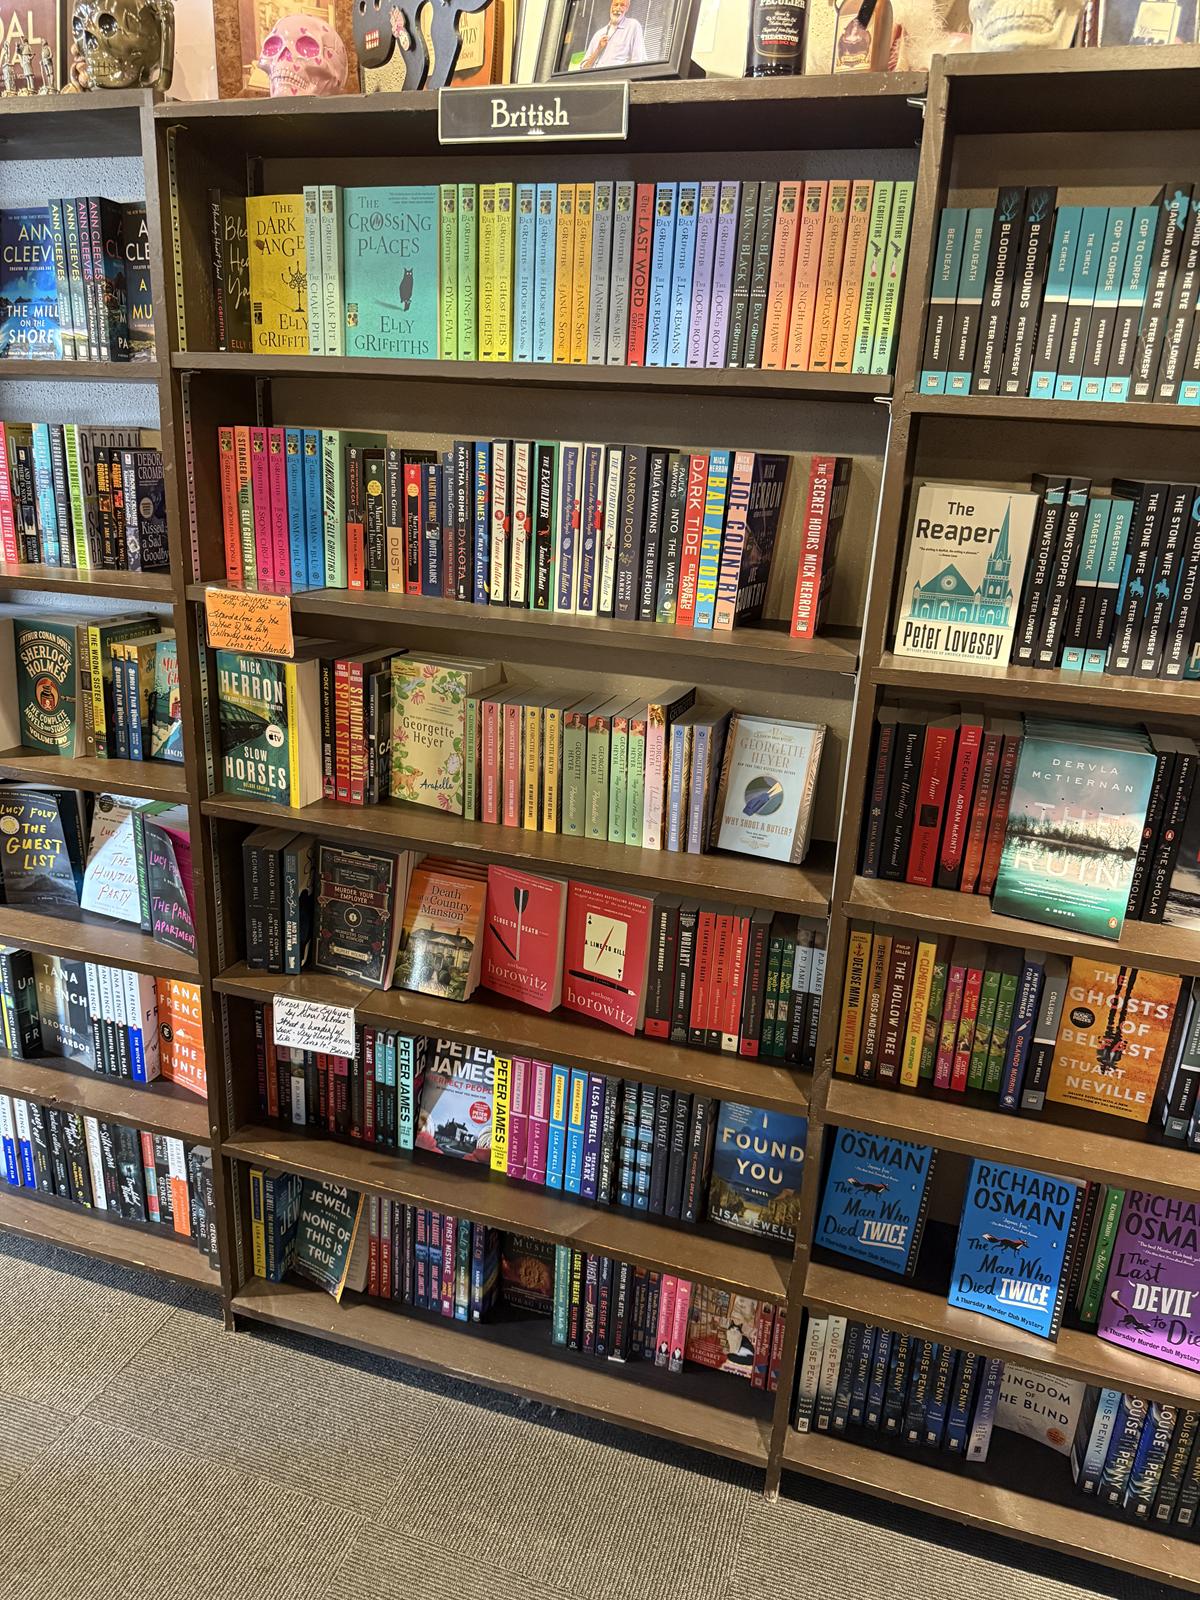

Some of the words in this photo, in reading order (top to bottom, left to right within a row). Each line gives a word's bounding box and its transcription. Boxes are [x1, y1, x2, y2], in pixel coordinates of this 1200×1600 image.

[491, 98, 569, 129] British
[79, 202, 87, 230] ANN
[272, 202, 293, 213] THE
[358, 196, 379, 208] THE
[51, 204, 61, 230] ANN
[67, 204, 75, 230] ANN
[257, 216, 295, 235] DARK
[358, 236, 419, 258] PLACES
[638, 217, 649, 253] LAST
[946, 228, 955, 247] BEAU
[4, 245, 54, 263] CLEEV
[53, 234, 65, 281] CLEEVES
[69, 234, 80, 281] CLEEVES
[80, 233, 92, 280] CLEEVES
[755, 245, 768, 282] BLACK
[991, 223, 1011, 307] BLOODHOUNDS
[1082, 249, 1092, 275] CIRCLE
[634, 260, 647, 307] WORD
[1130, 255, 1142, 290] CORPSE
[7, 305, 27, 317] THE
[34, 305, 59, 317] MILL
[327, 283, 336, 319] CHALK
[464, 286, 472, 319] DYING
[864, 288, 874, 327] POSTSCRIPT
[9, 329, 54, 344] SHORE
[280, 314, 309, 330] ELLY
[328, 323, 336, 342] PIT
[381, 316, 414, 334] ELLY
[672, 308, 682, 353] REMAINS
[355, 335, 429, 354] GRIFFITHS
[795, 323, 803, 352] HAWKS
[981, 338, 994, 374] LOVESEY
[237, 439, 247, 474] STRANGER
[495, 467, 505, 508] APPEAL
[652, 459, 662, 488] PAULA
[690, 460, 704, 510] DARK
[540, 468, 550, 518] EXAMINER
[627, 466, 637, 515] NARROW
[729, 477, 750, 511] JOE
[811, 478, 826, 515] SECRET
[1148, 493, 1159, 511] THE
[649, 490, 659, 533] HAWKINS
[670, 509, 679, 533] INTO
[948, 502, 974, 516] The
[148, 536, 162, 547] Sad
[624, 518, 633, 548] DOOR
[685, 518, 699, 555] TIDE
[807, 518, 821, 550] HOURS
[916, 519, 1000, 545] Reaper
[1108, 515, 1124, 572] STAGESTRUCK
[1141, 515, 1154, 547] STONE
[391, 538, 399, 574] DUST
[458, 529, 466, 579] DAKOTA
[717, 520, 745, 603] COUNTRY
[1057, 512, 1079, 587] SHOWSTOPPER
[1136, 551, 1148, 574] WIFE
[665, 562, 675, 595] WATER
[697, 527, 722, 602] ACTORS
[803, 553, 816, 578] MICK
[1183, 566, 1197, 601] TATTOO
[799, 581, 813, 618] HERRON
[903, 622, 941, 651] Peter
[945, 626, 1003, 659] Lovesey
[20, 646, 72, 671] SHERLOCK
[27, 659, 66, 683] HOLMES
[91, 649, 100, 674] WRONG
[240, 660, 261, 675] MICK
[93, 676, 102, 702] SISTER
[220, 670, 283, 704] HERRON
[335, 683, 348, 724] SPOOK
[350, 687, 363, 742] STANDING
[403, 717, 454, 738] Georgette
[414, 732, 444, 748] Heyer
[244, 747, 267, 760] SLOW
[336, 730, 350, 779] STREET
[739, 738, 805, 759] GEORGETTE
[225, 756, 287, 790] HORSES
[1052, 759, 1118, 775] DERVLA
[1032, 771, 1133, 793] McTIERNAN
[22, 823, 47, 834] THE
[7, 837, 63, 854] GUEST
[24, 855, 55, 870] LIST
[1014, 851, 1120, 888] RUIN
[335, 886, 357, 895] MURDER
[359, 891, 374, 899] YOUR
[340, 893, 368, 904] EMPLOYER
[431, 885, 461, 899] Death
[1127, 866, 1143, 912] SCHOLAR
[421, 904, 465, 921] Mansion
[430, 896, 471, 913] Country
[680, 931, 692, 967] MORIARTY
[43, 964, 78, 985] TANA
[488, 959, 547, 992] horowitz
[896, 961, 906, 980] THE
[1094, 970, 1127, 986] THE
[39, 983, 88, 1007] FRENCH
[568, 987, 634, 1027] horowitz
[889, 984, 902, 1028] HOLLOW
[1069, 987, 1170, 1019] GHOSTS
[42, 1018, 76, 1035] BROKEN
[843, 1010, 857, 1056] CONVICTION
[1120, 1021, 1151, 1036] OF
[56, 1035, 90, 1054] HARBOR
[885, 1031, 897, 1055] TREE
[430, 1056, 495, 1084] JAMES
[497, 1059, 508, 1104] PETER
[1008, 1068, 1018, 1094] MURRIN
[1059, 1057, 1126, 1079] STUART
[1066, 1076, 1147, 1104] NEVILLE
[495, 1107, 506, 1143] JAMES
[722, 1128, 804, 1162] FOUND
[841, 1134, 925, 1174] OSMAN
[736, 1158, 782, 1184] YOU
[310, 1189, 352, 1217] JEWELL
[974, 1188, 1065, 1231] OSMAN
[303, 1210, 336, 1235] NONE
[338, 1227, 350, 1242] OF
[711, 1206, 739, 1222] LISA
[745, 1215, 795, 1238] JEWELL
[862, 1220, 908, 1245] TWICE
[306, 1228, 331, 1252] THIS
[334, 1243, 343, 1256] IS
[967, 1238, 989, 1251] The
[309, 1245, 335, 1269] TRUE
[977, 1254, 1014, 1276] Man
[1018, 1257, 1052, 1283] Who
[1116, 1253, 1166, 1283] Last
[958, 1274, 996, 1295] Died
[999, 1279, 1051, 1306] TWICE
[1132, 1284, 1192, 1318] DEVIL
[961, 1298, 985, 1310] Thursday
[987, 1305, 1007, 1316] Murder
[1021, 1316, 1044, 1331] Mystery
[829, 1328, 840, 1361] LOUISE
[1023, 1401, 1069, 1425] BLIND
[1153, 1404, 1175, 1447] LOUISE
[1139, 1463, 1159, 1502] PENNY
